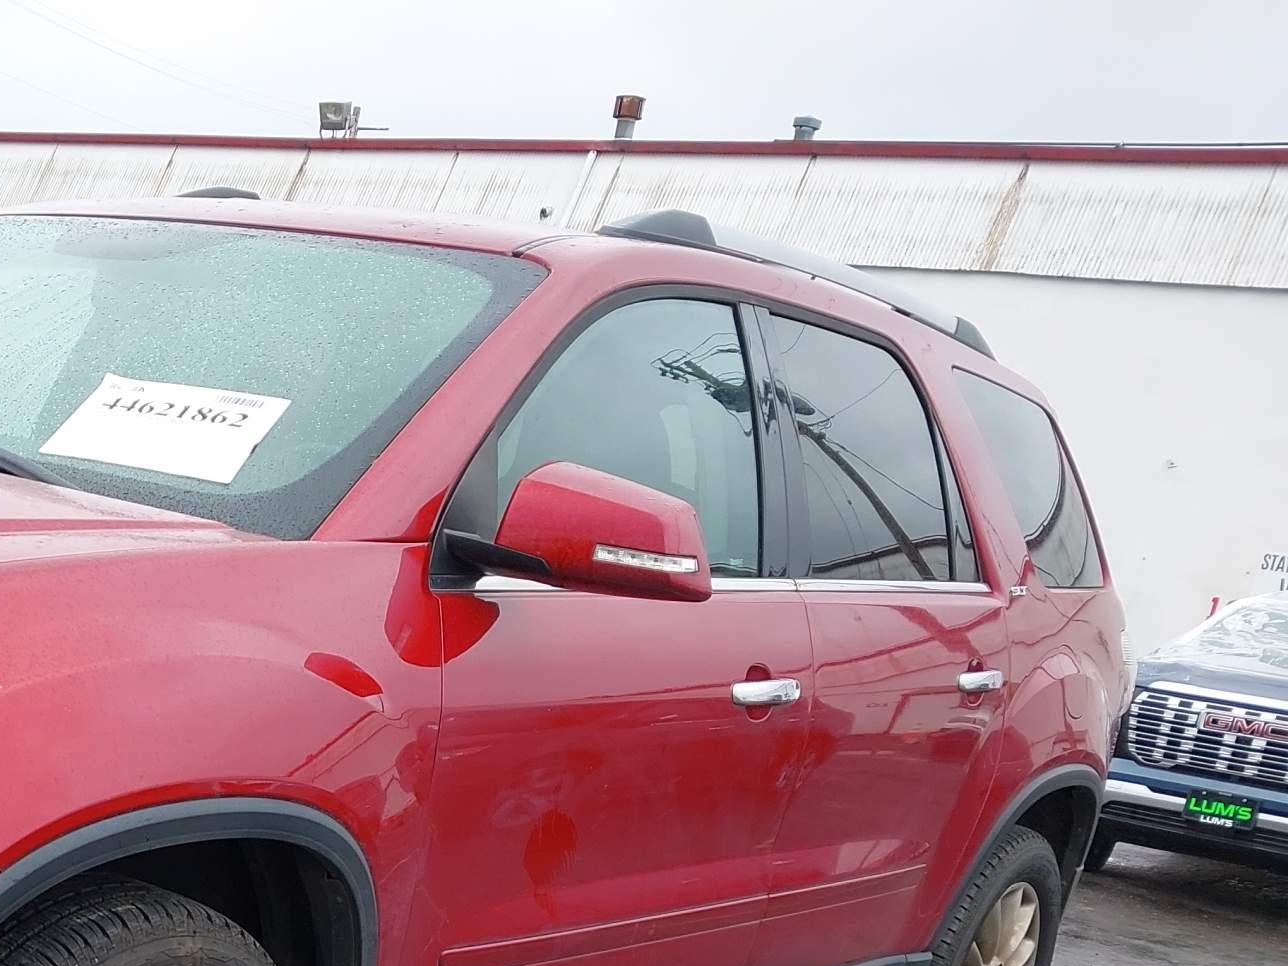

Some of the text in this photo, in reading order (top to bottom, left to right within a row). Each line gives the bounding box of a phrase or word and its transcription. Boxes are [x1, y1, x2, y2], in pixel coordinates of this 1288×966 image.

[102, 397, 249, 428] 44621862
[1261, 553, 1288, 573] STA
[1202, 712, 1288, 742] GMC
[1188, 797, 1253, 821] LUM'S
